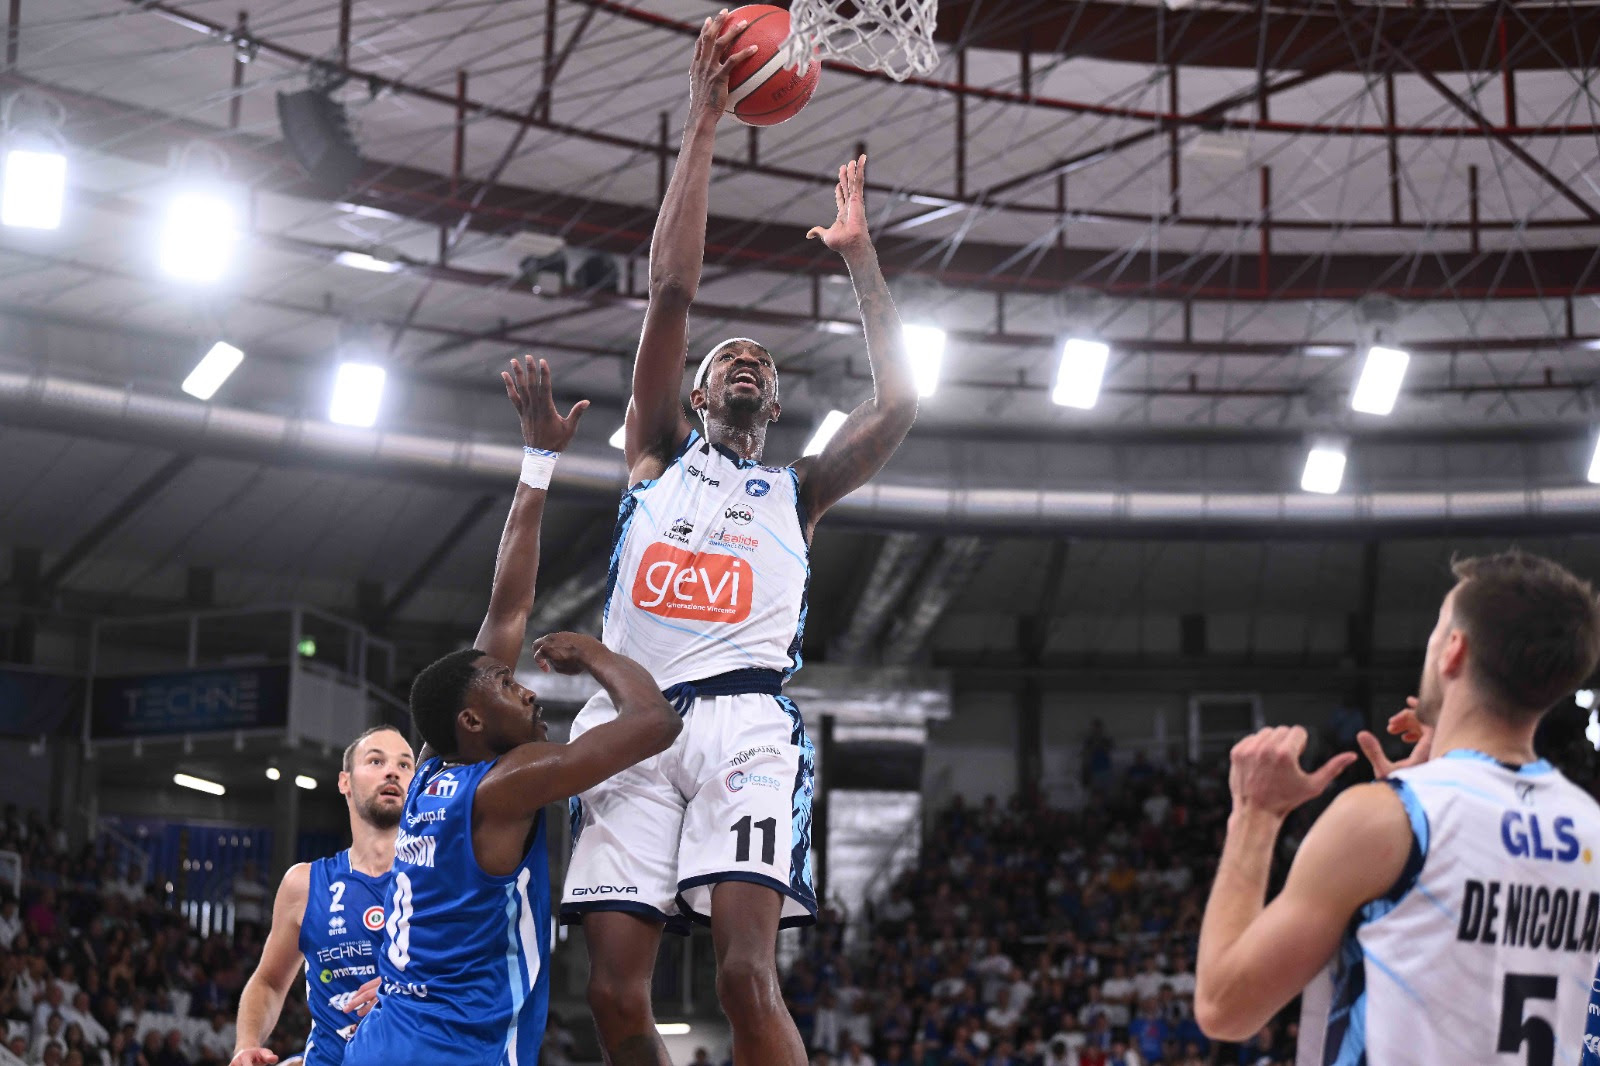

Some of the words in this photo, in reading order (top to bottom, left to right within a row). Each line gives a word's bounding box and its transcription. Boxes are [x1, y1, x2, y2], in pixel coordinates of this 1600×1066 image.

[639, 560, 741, 608] gevi
[730, 815, 777, 866] 11
[329, 881, 346, 913] 2
[571, 885, 638, 896] GIVOVA
[385, 872, 414, 972] 0
[1456, 879, 1501, 945] DE
[1502, 883, 1600, 955] NICOLA
[316, 943, 373, 963] TECHNE
[1496, 973, 1558, 1066] 5
